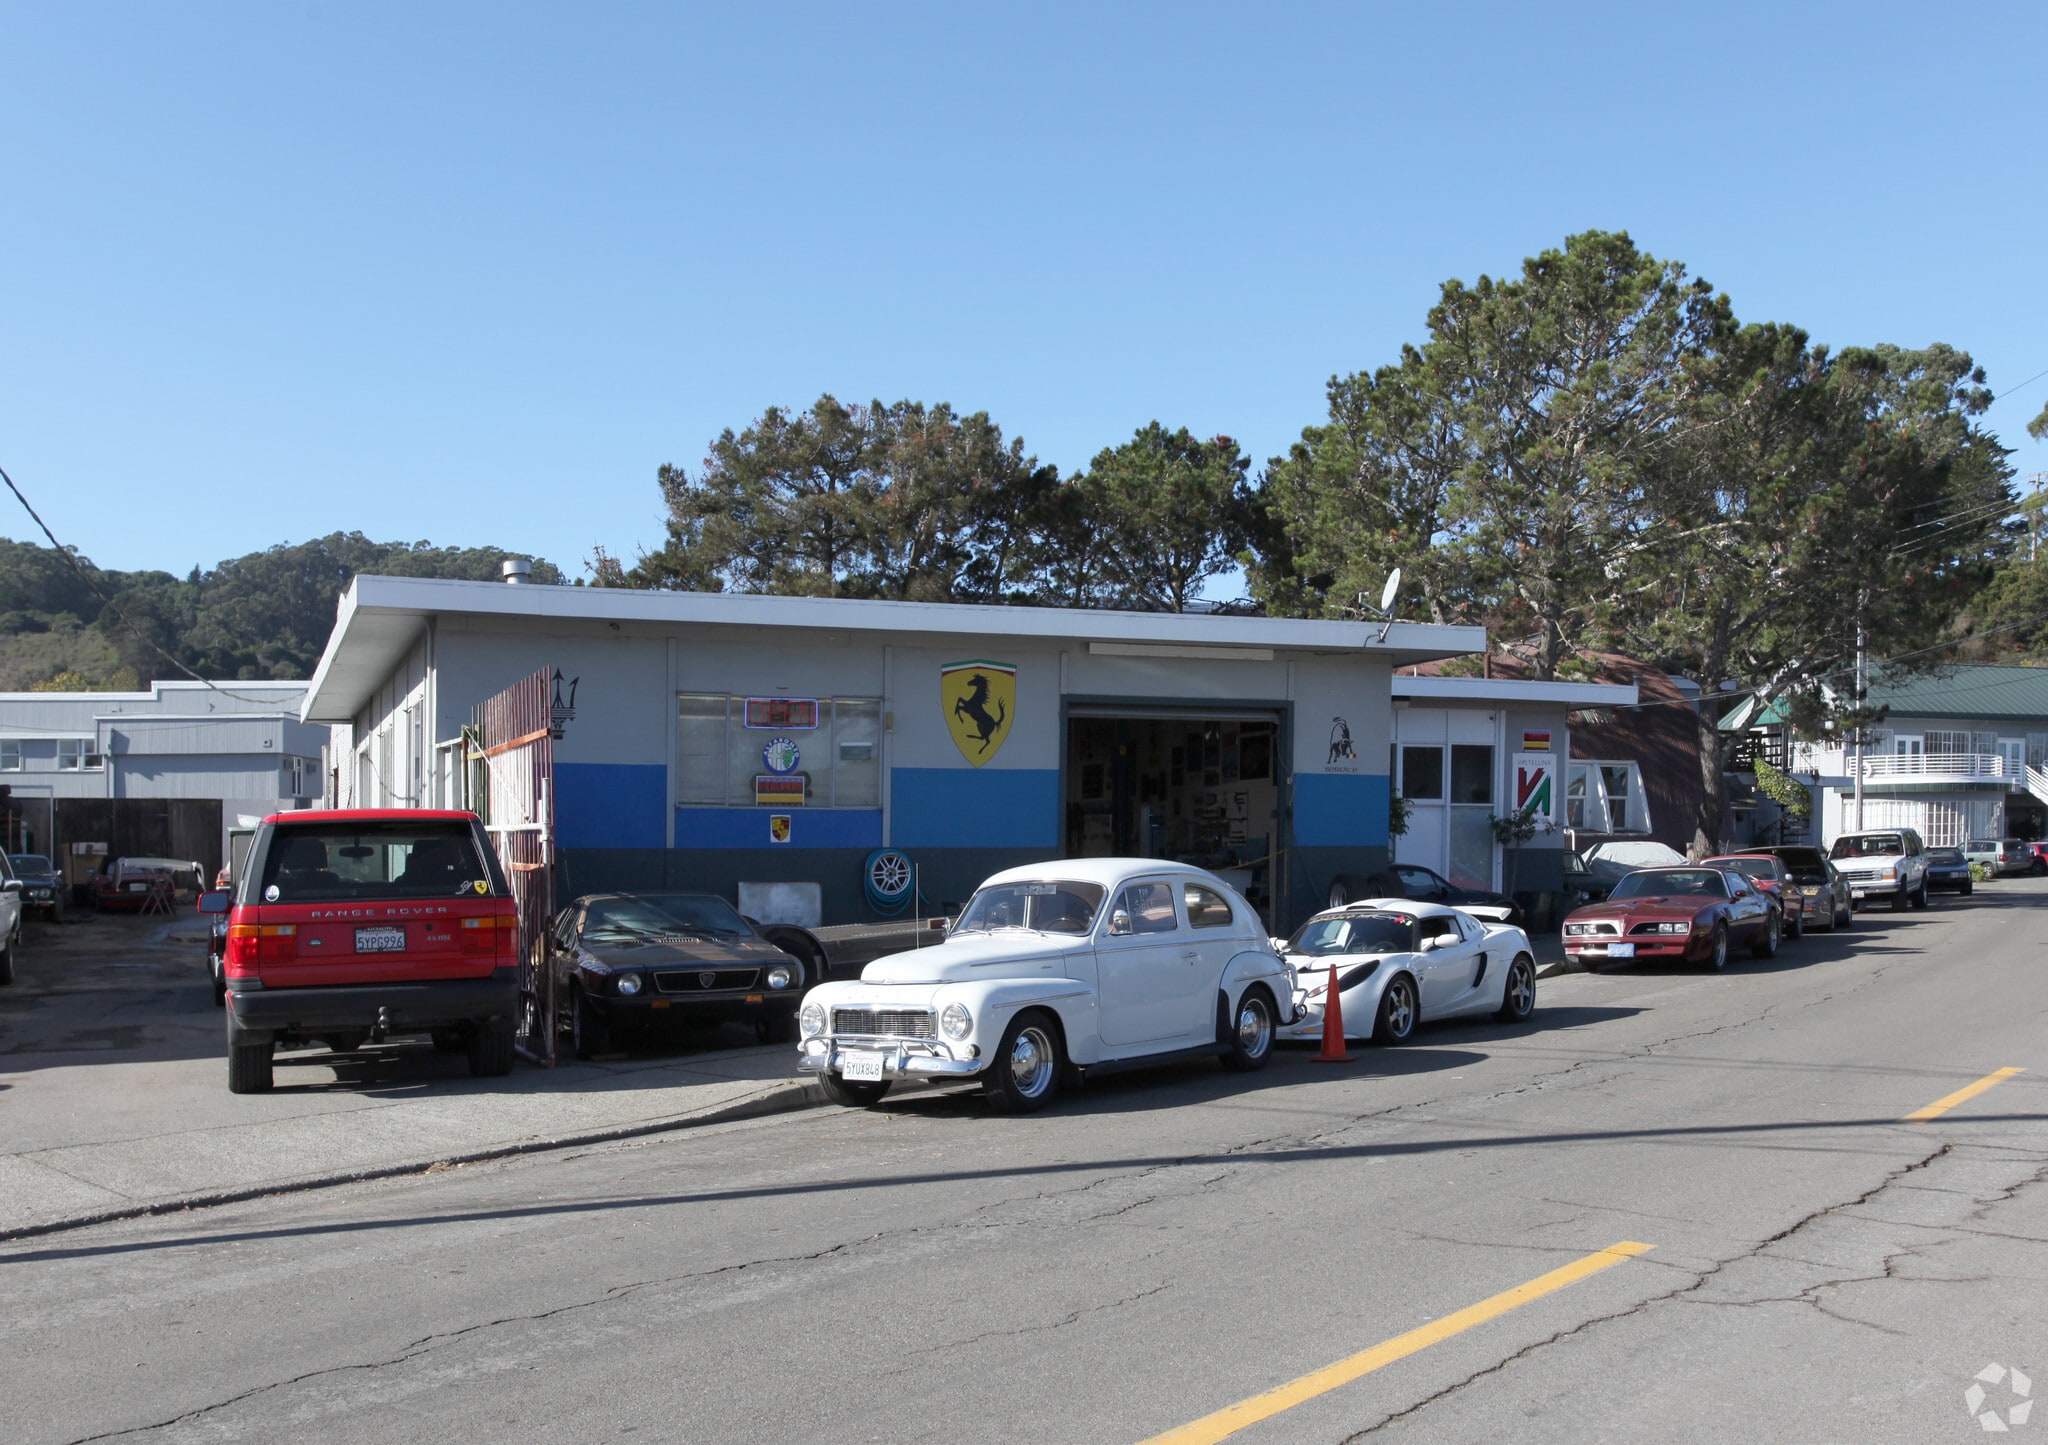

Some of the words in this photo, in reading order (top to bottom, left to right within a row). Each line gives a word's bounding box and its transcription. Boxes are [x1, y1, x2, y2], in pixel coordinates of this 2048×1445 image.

[748, 701, 815, 726] OPEN
[311, 909, 375, 918] RANGE
[387, 906, 447, 916] ROVER
[357, 936, 403, 950] 5YPG996
[846, 1062, 880, 1076] 5YUX848
